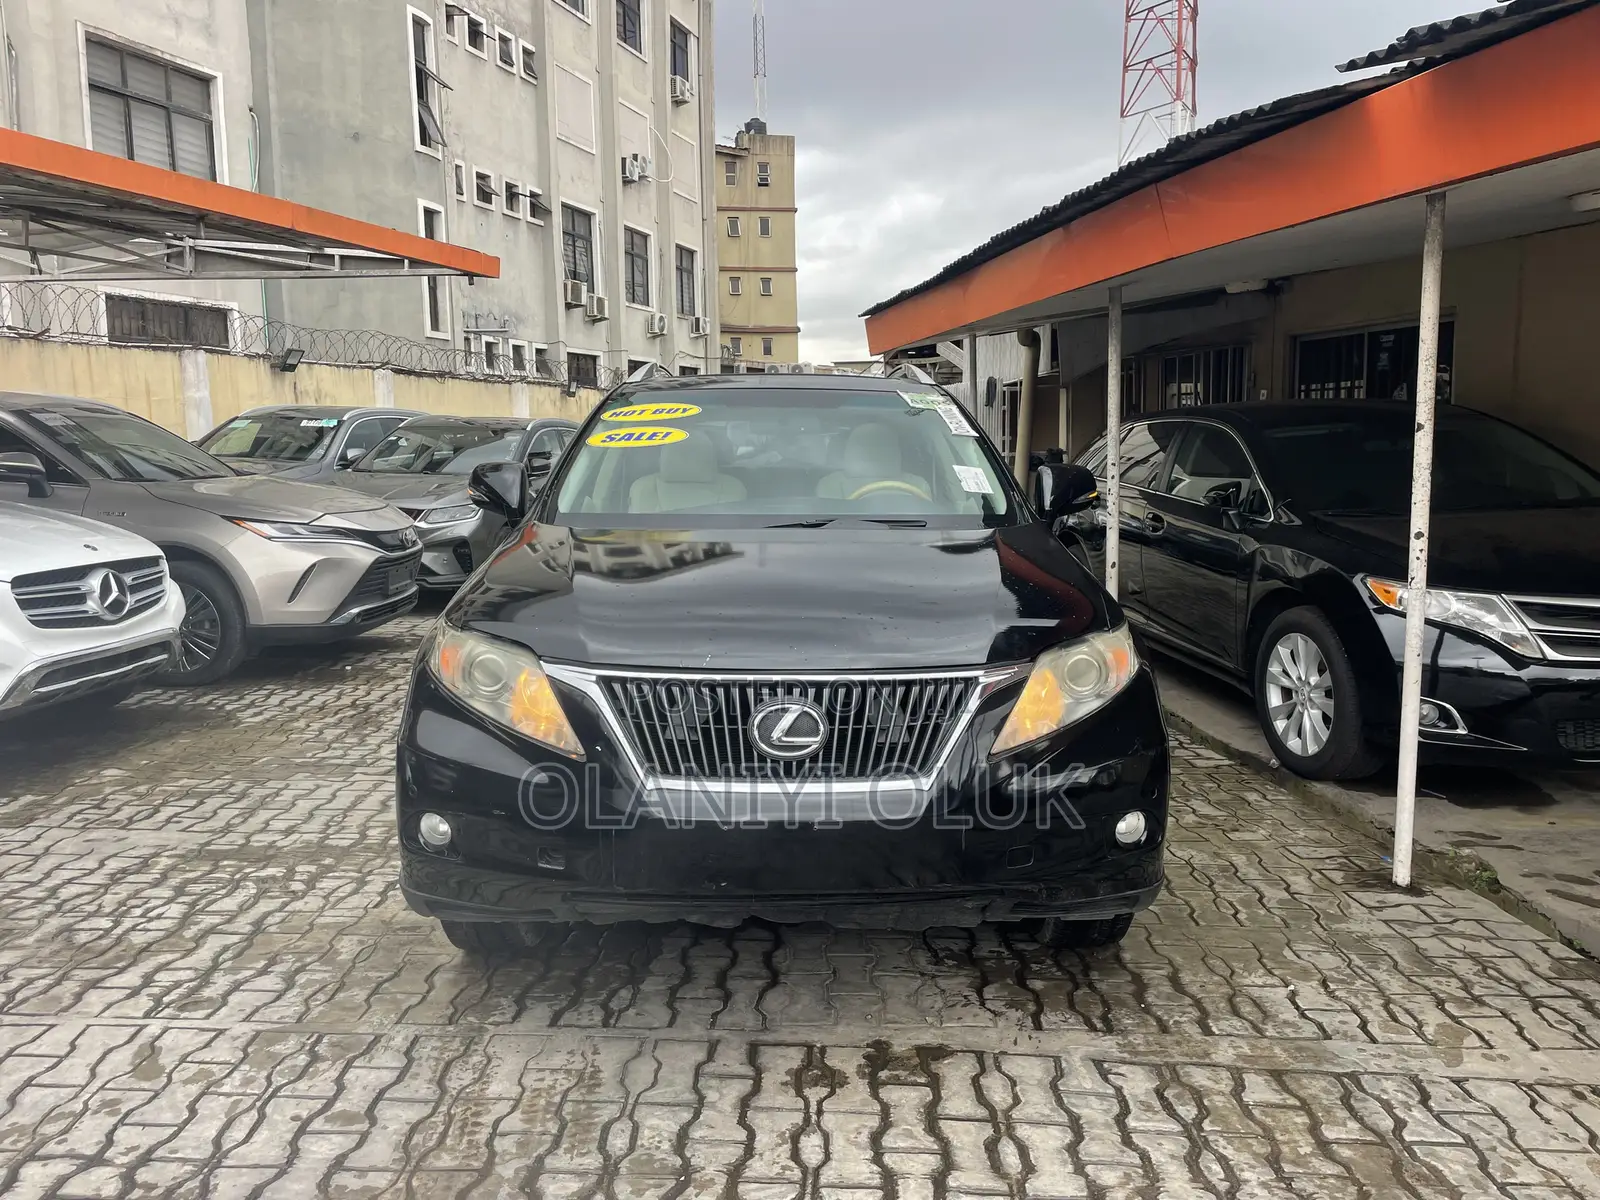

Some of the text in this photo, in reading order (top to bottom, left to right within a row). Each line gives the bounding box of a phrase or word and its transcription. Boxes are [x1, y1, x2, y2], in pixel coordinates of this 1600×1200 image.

[608, 407, 694, 418] HOT BUY
[600, 431, 672, 443] SALE!
